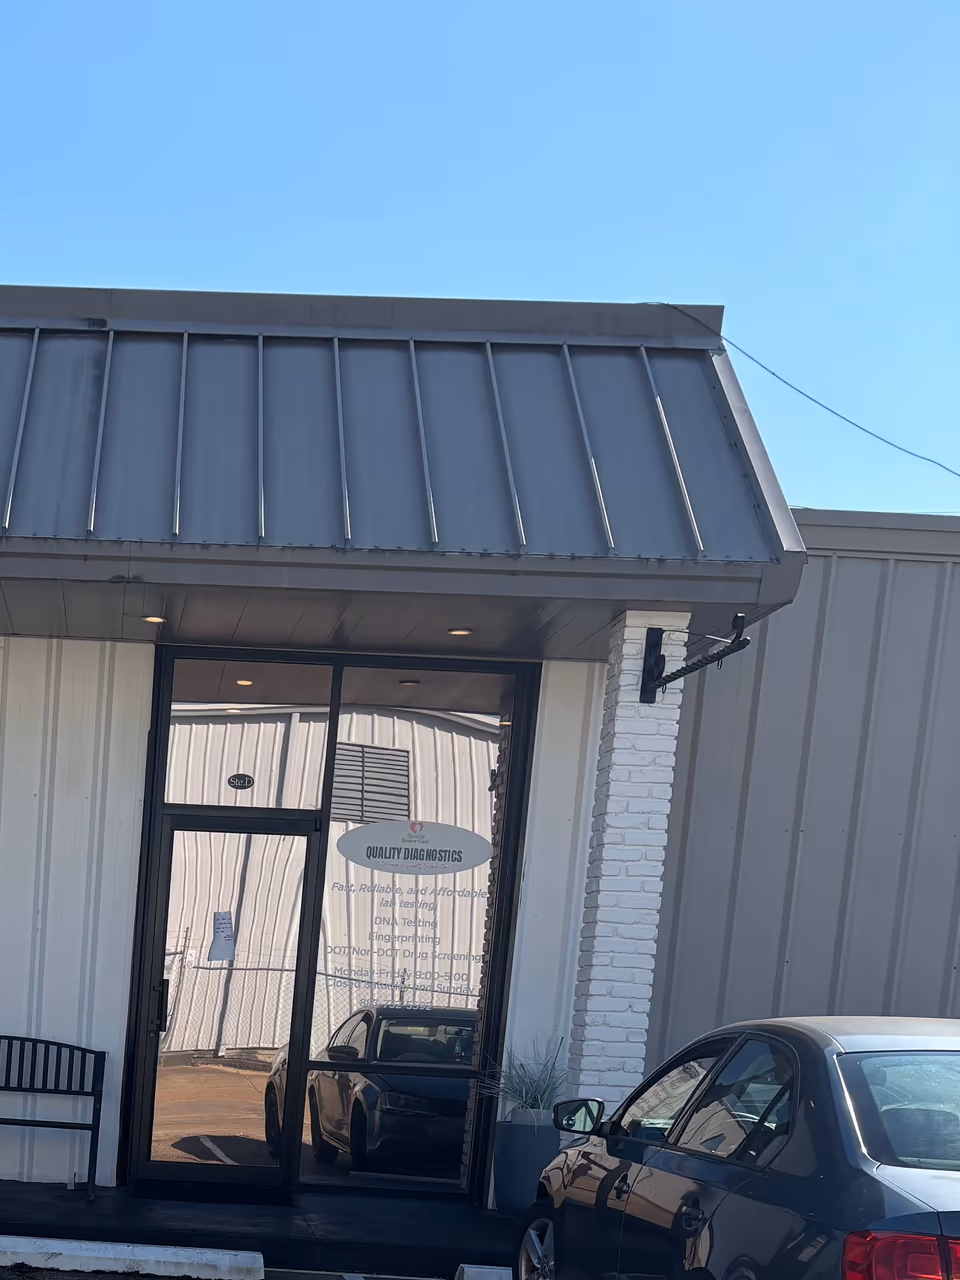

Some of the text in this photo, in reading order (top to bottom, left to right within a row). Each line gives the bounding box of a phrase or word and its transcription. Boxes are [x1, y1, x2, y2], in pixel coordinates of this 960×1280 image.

[365, 845, 463, 863] QUALITY DIAGNOSTICS
[331, 882, 488, 899] Fast, Reliable, and Affordable
[380, 898, 436, 912] lab testing
[374, 916, 438, 930] DNA Testing
[368, 932, 441, 946] Fingerprinting
[403, 950, 428, 961] Drug
[430, 951, 482, 963] Screening
[415, 970, 469, 982] 9:00-5:00
[326, 978, 363, 989] Closed
[413, 983, 432, 992] and
[436, 983, 475, 994] Sunday
